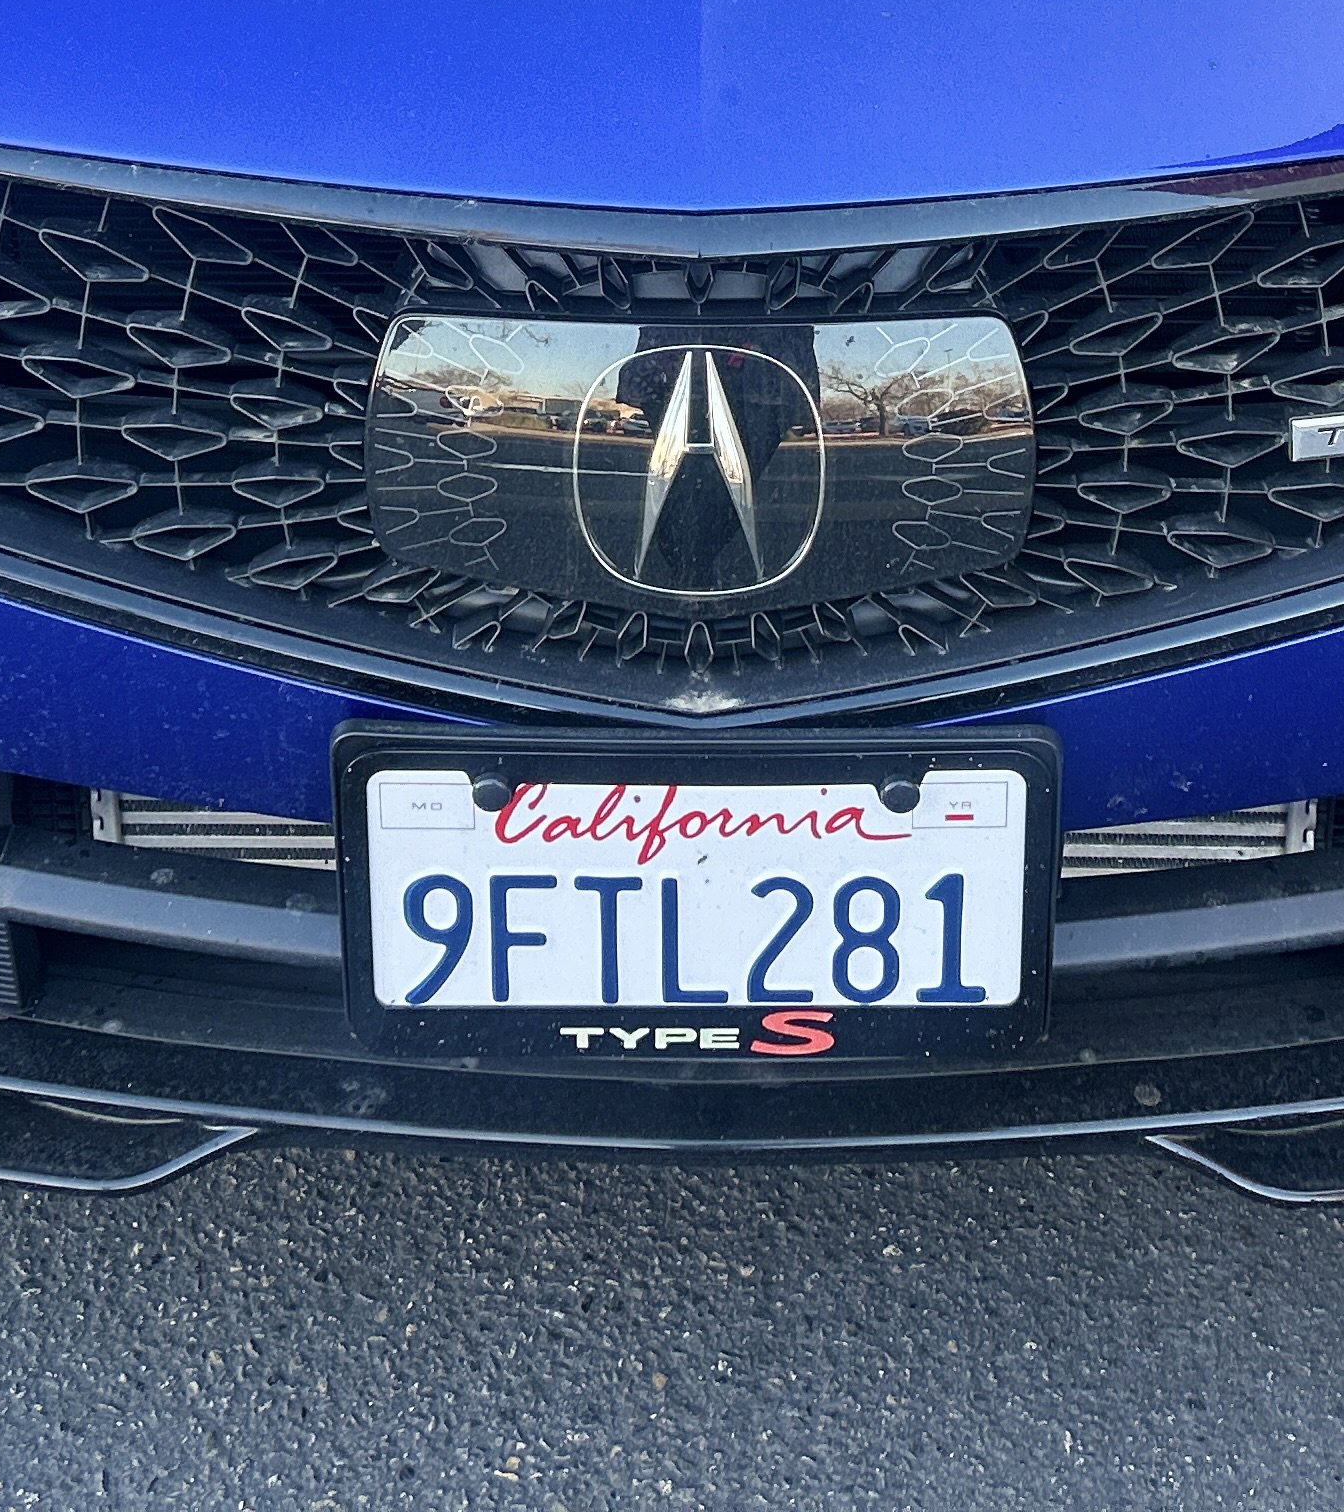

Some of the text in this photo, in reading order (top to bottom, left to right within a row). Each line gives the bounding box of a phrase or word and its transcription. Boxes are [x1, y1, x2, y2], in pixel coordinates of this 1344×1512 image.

[411, 802, 443, 811] MO
[495, 782, 913, 865] California
[403, 874, 988, 1004] 9FTL281
[559, 1009, 835, 1056] TYPE S
